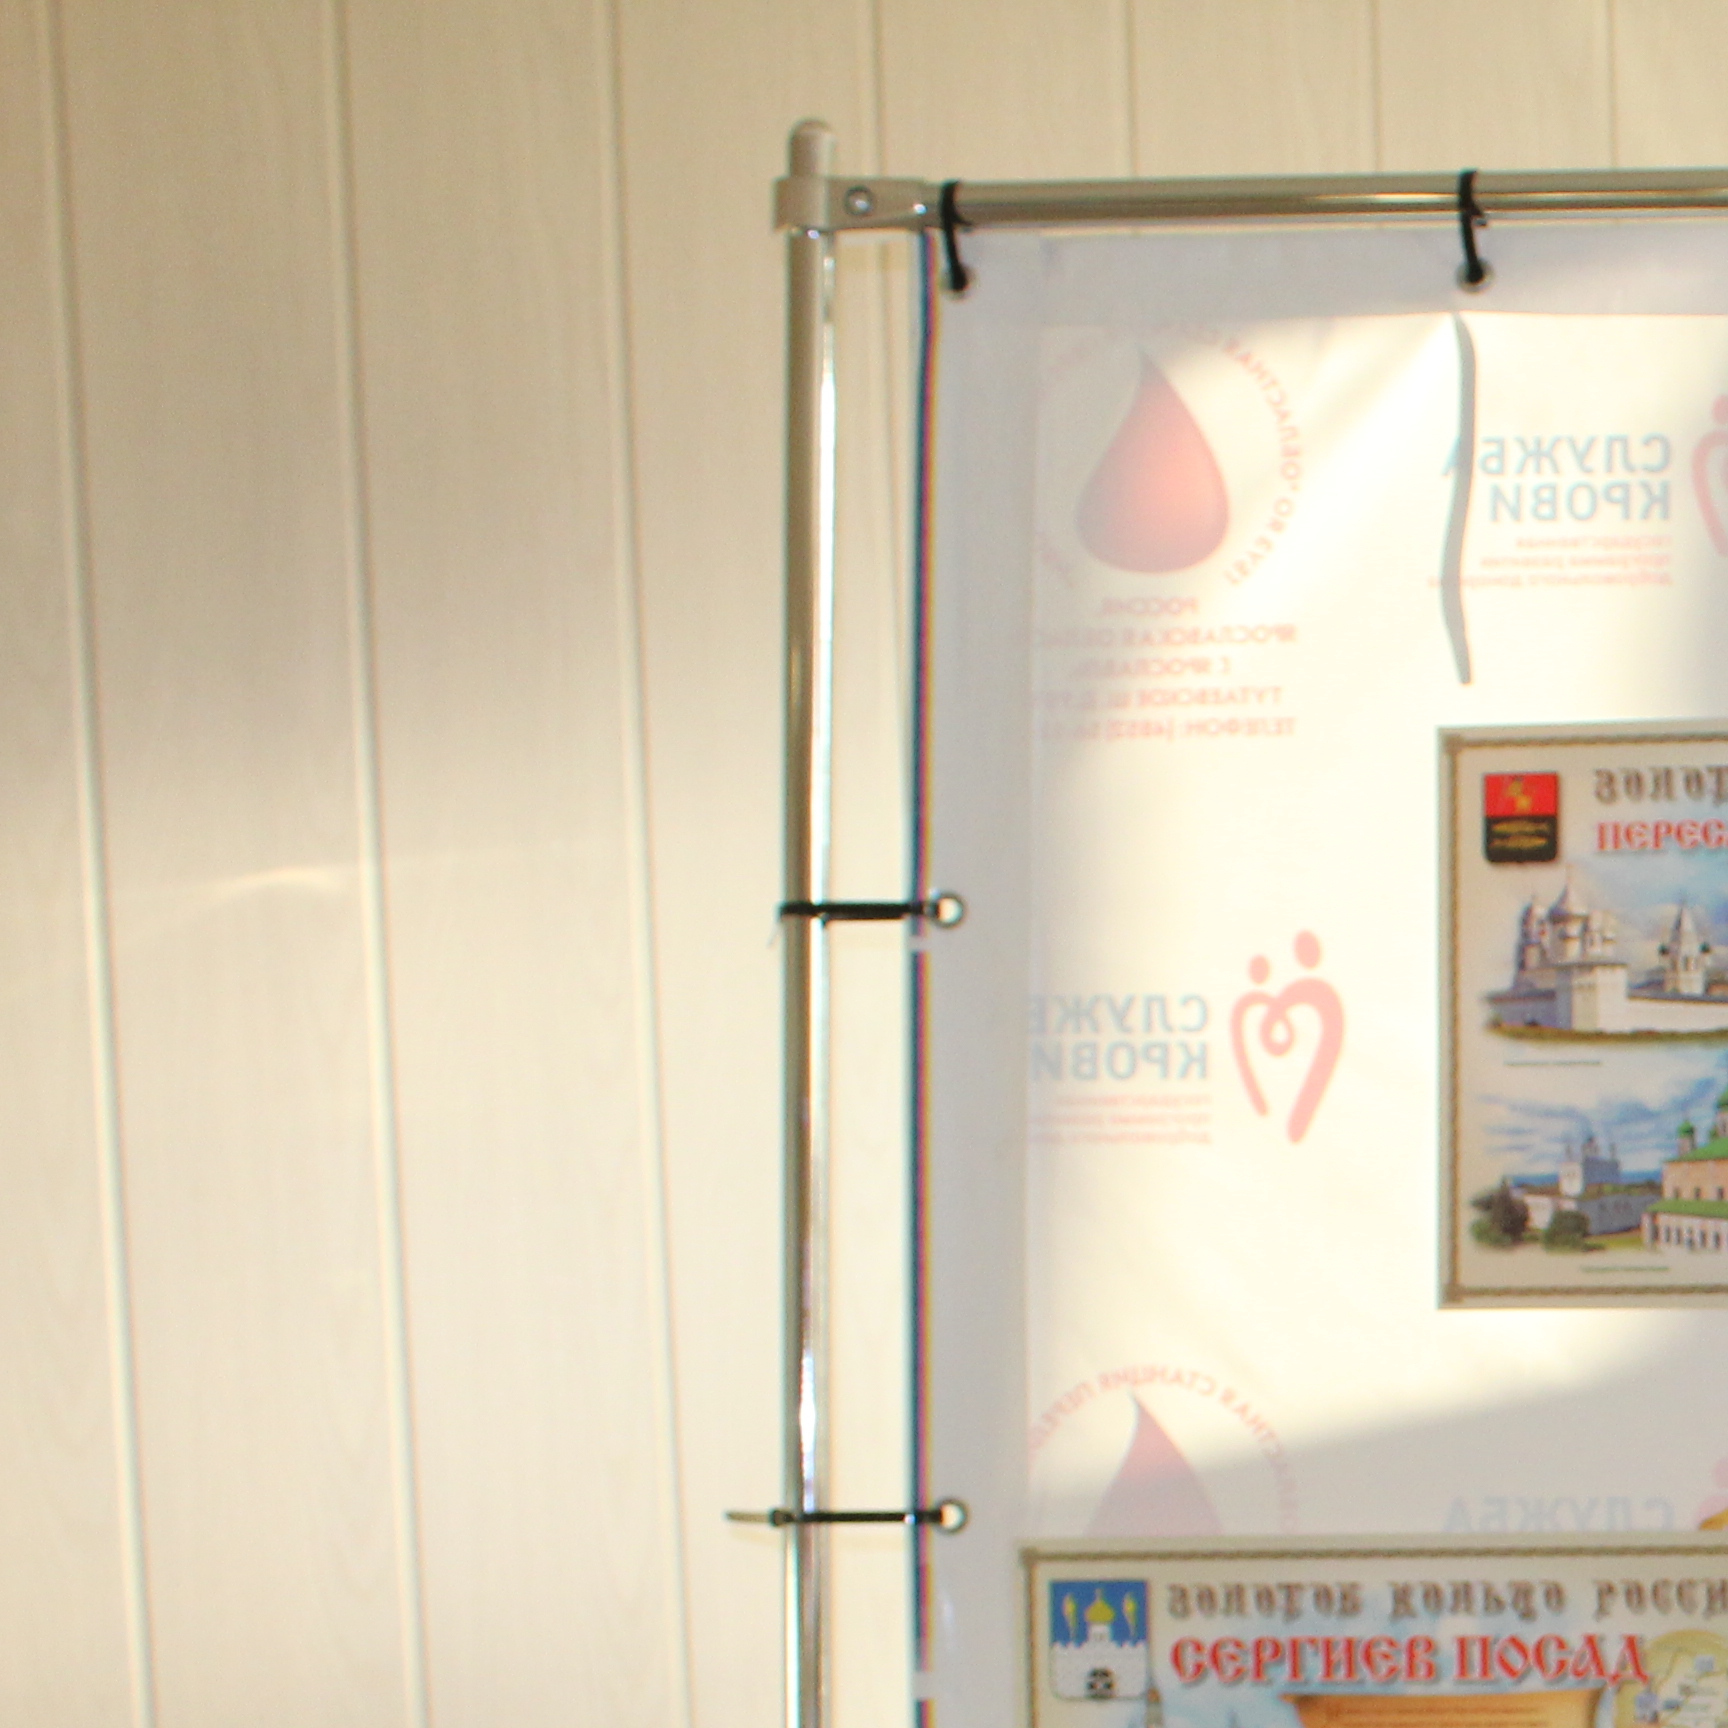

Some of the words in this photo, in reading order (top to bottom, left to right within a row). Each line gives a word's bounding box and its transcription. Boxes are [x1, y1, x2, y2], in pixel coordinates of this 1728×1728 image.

[1166, 1581, 1363, 1621] ЗОЛОТОЕ
[1388, 1580, 1568, 1621] КОЛЬЦО
[1170, 1635, 1437, 1686] СЕРГИЕВ
[1455, 1634, 1649, 1686] ПОСАД
